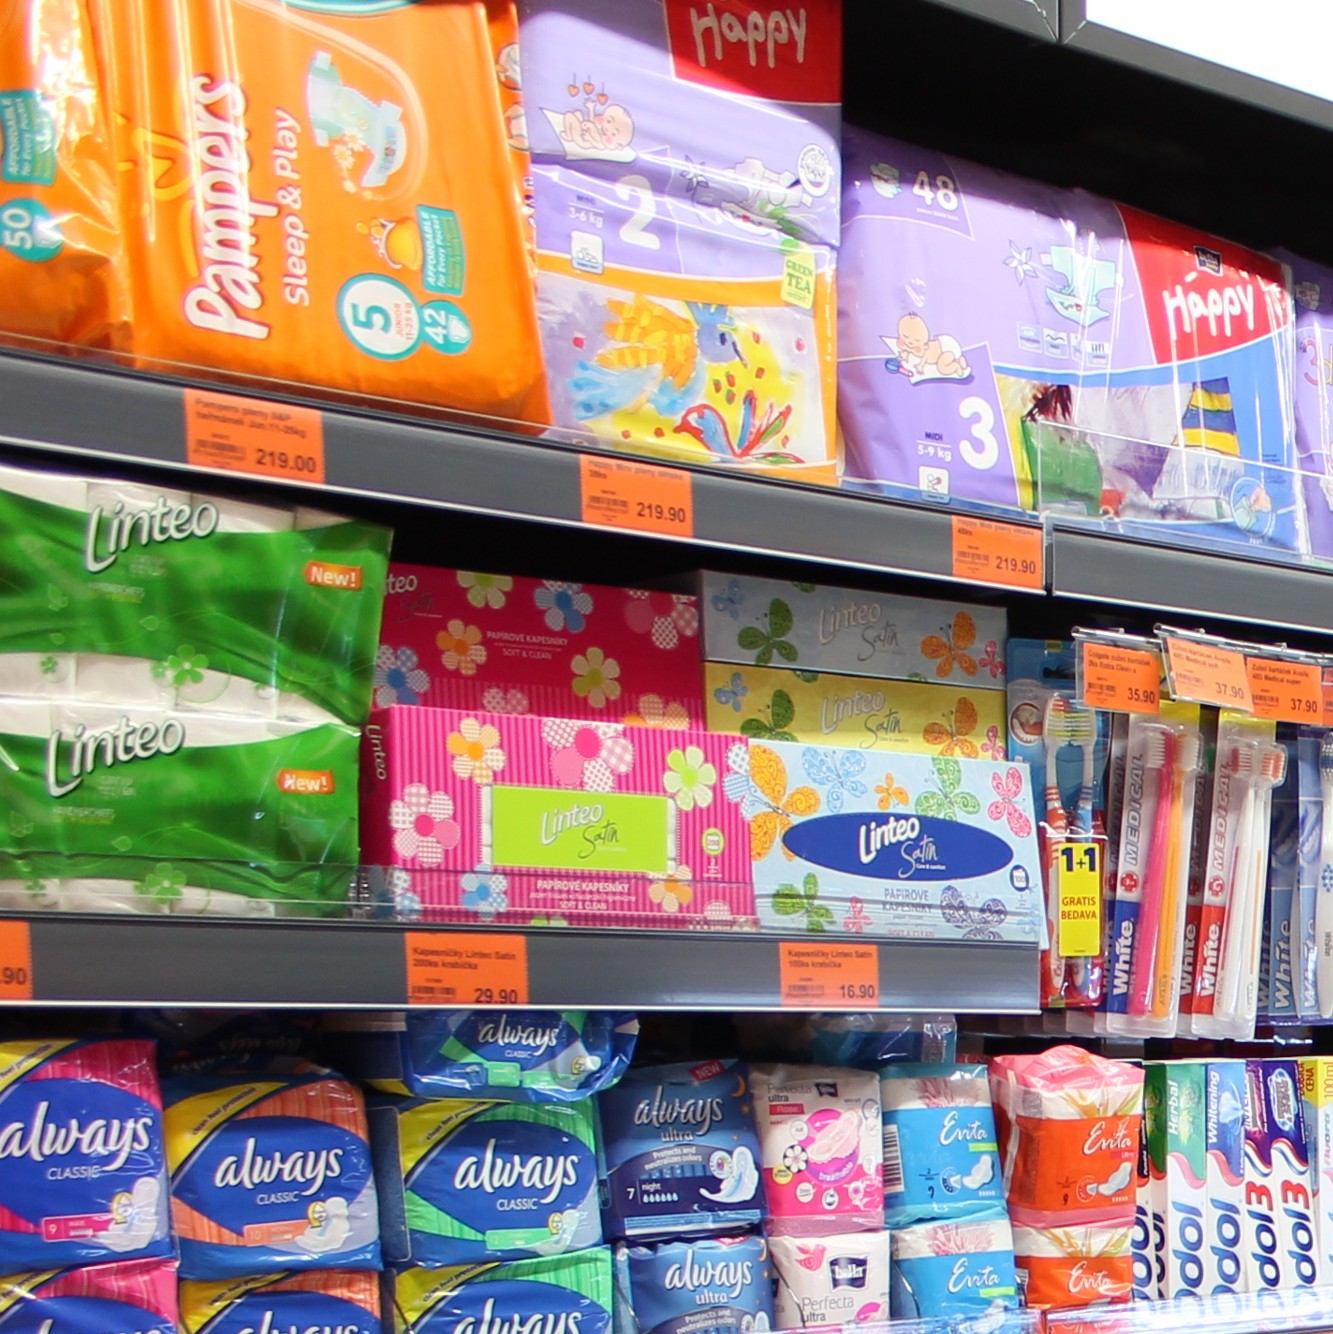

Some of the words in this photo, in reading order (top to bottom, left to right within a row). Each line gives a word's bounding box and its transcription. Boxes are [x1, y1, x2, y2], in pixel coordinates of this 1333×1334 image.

[690, 3, 807, 68] Happy
[276, 109, 301, 178] Play
[278, 184, 301, 210] &
[912, 170, 959, 212] 48
[184, 74, 278, 340] Pampers
[615, 173, 662, 250] 2
[5, 208, 32, 249] 50
[282, 215, 309, 307] Sleep
[785, 259, 813, 279] GREEN
[787, 272, 812, 294] TEA
[352, 299, 392, 333] 5
[430, 308, 449, 345] 42
[959, 396, 1000, 471] 3
[256, 448, 316, 473] 219.00
[636, 501, 687, 524] 219.90
[84, 497, 218, 573] Linteo
[310, 566, 357, 589] New!
[995, 556, 1037, 575] 219.90
[860, 623, 900, 662] Satin
[1127, 687, 1155, 704] 35.90
[1216, 682, 1245, 700] 37.90
[1290, 698, 1318, 713] 37.90
[47, 718, 185, 798] Linteo
[283, 773, 328, 793] New!
[1124, 753, 1144, 866] MEDICAL
[858, 816, 920, 863] Linteo
[1061, 846, 1097, 873] 1+1
[1061, 896, 1096, 907] GRATIS
[1061, 910, 1098, 921] BEDAVA
[1112, 919, 1135, 996] White
[1198, 922, 1221, 1001] White
[474, 988, 518, 1004] 29.90
[839, 984, 875, 999] 16.90
[695, 1063, 721, 1078] NEW
[1168, 1081, 1179, 1135] Herbal
[1208, 1071, 1220, 1144] Whitening
[661, 1128, 693, 1142] ultra
[940, 1111, 987, 1147] Evita
[46, 1164, 104, 1180] CLASSIC
[214, 1138, 344, 1196] always
[454, 1138, 579, 1202] always
[256, 1192, 299, 1206] CLASSIC
[496, 1197, 538, 1210] CLASSIC
[627, 1189, 635, 1199] 7
[949, 1260, 1000, 1294] Evita
[802, 1296, 855, 1315] Perfecta
